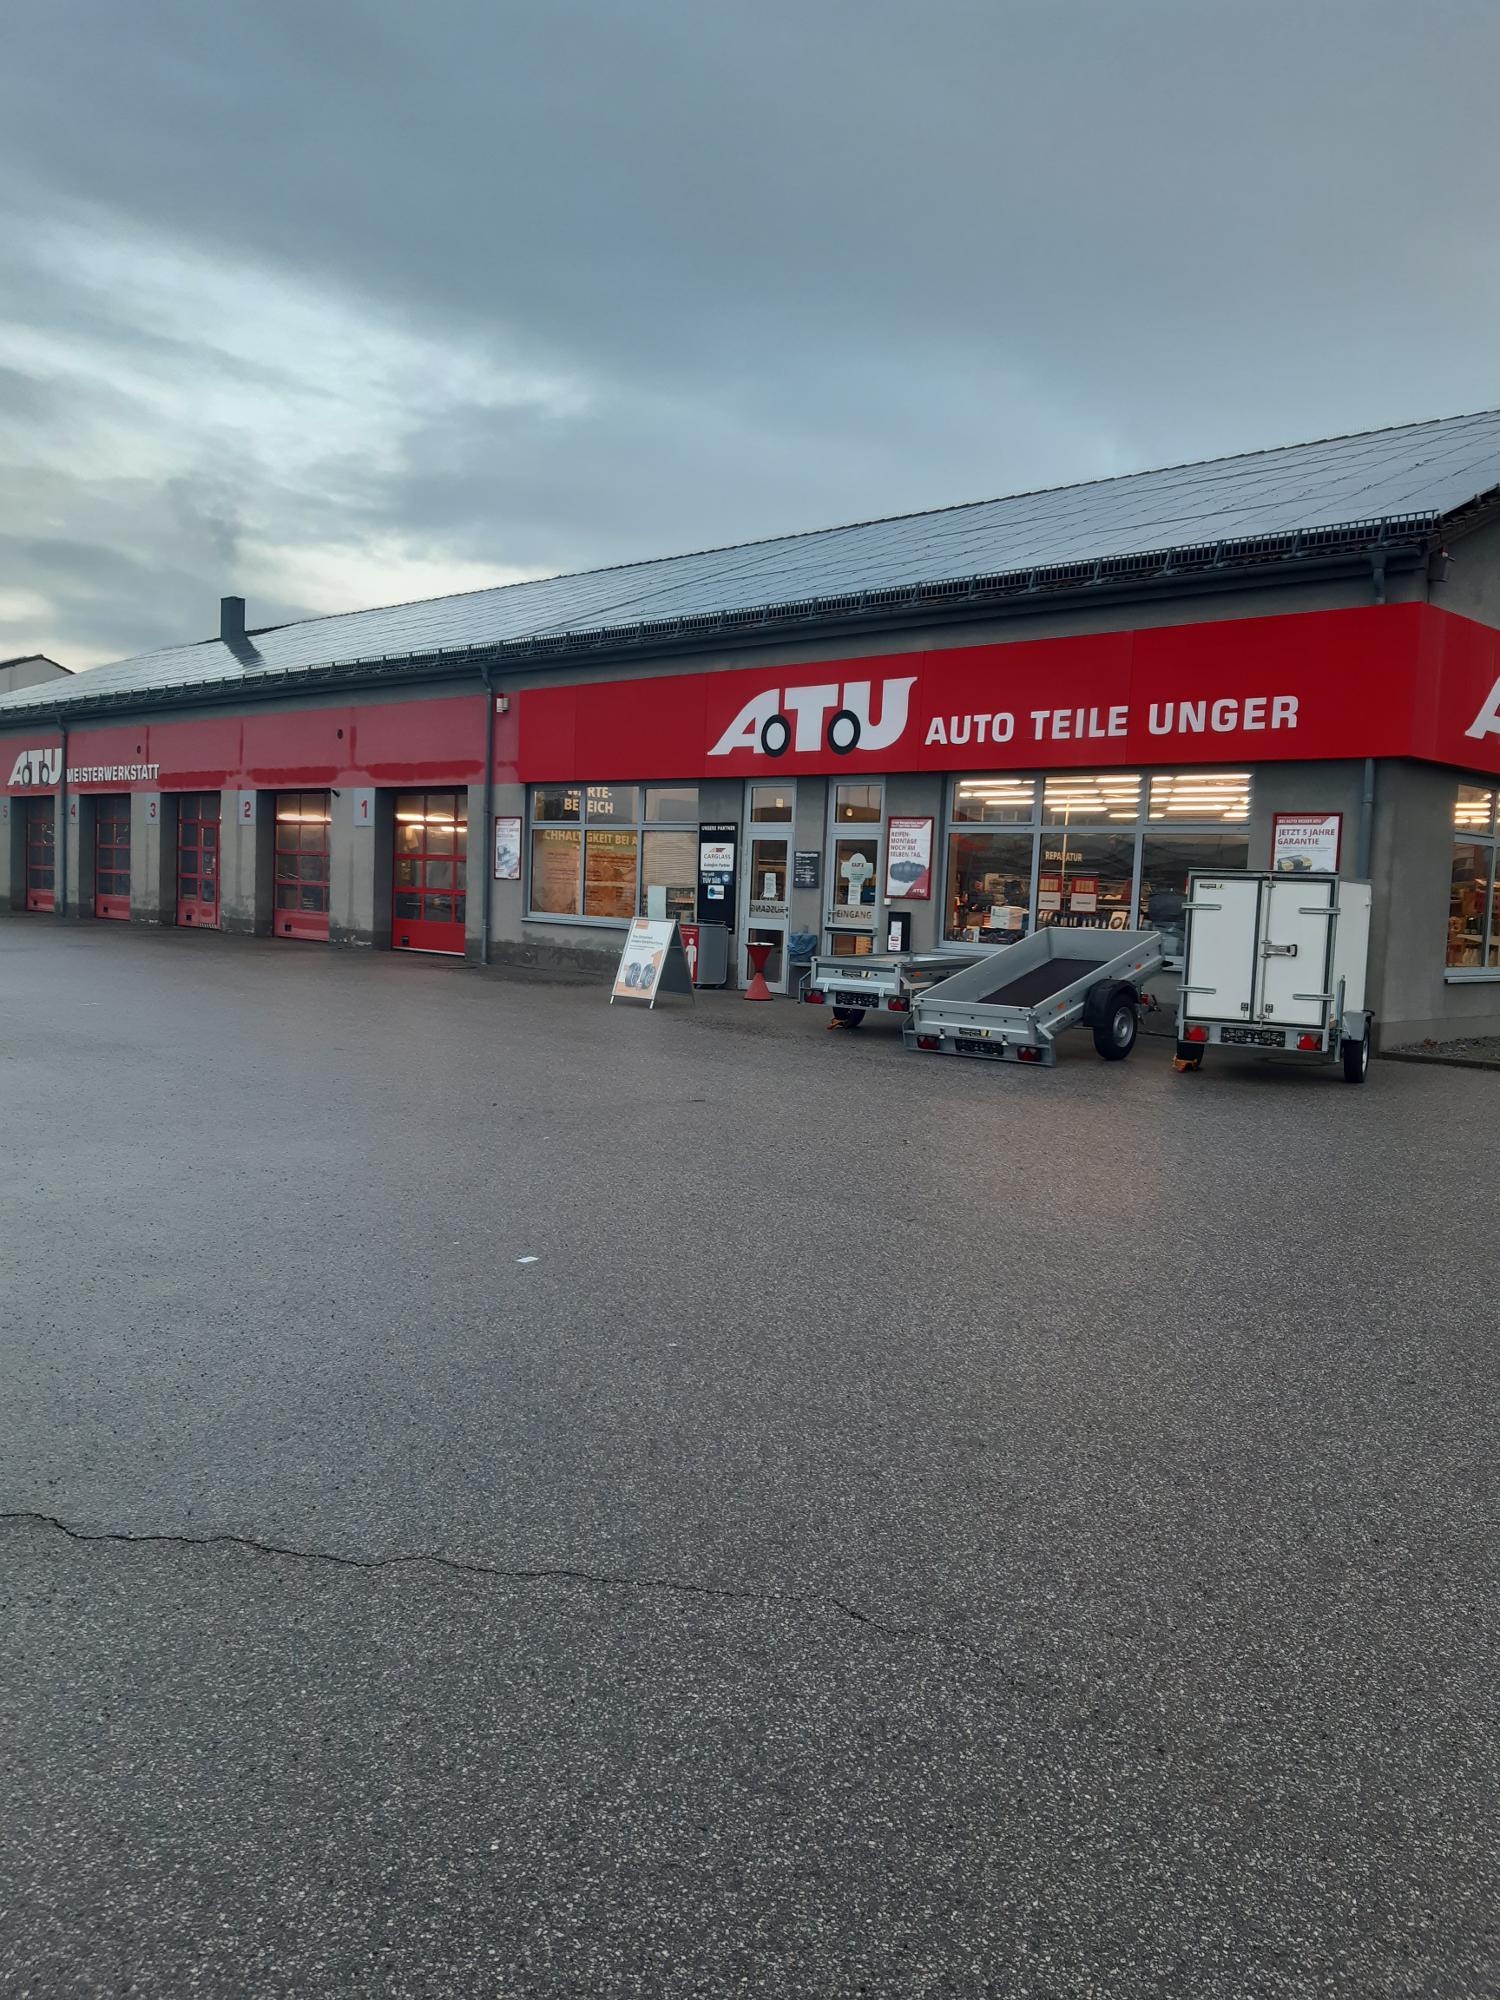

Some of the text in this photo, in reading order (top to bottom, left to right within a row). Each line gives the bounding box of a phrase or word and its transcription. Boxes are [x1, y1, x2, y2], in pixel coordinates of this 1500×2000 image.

[924, 695, 1299, 745] AUTO TEILE UNGER
[66, 764, 159, 782] MEISTERWERKSTATT
[70, 804, 76, 817] 4
[150, 803, 156, 818] 3
[244, 801, 251, 818] 2
[361, 800, 367, 818] 1
[563, 798, 613, 814] BEEICH
[1279, 829, 1300, 837] JETZT
[1309, 829, 1335, 837] JAHRE
[837, 910, 871, 919] EINGANG
